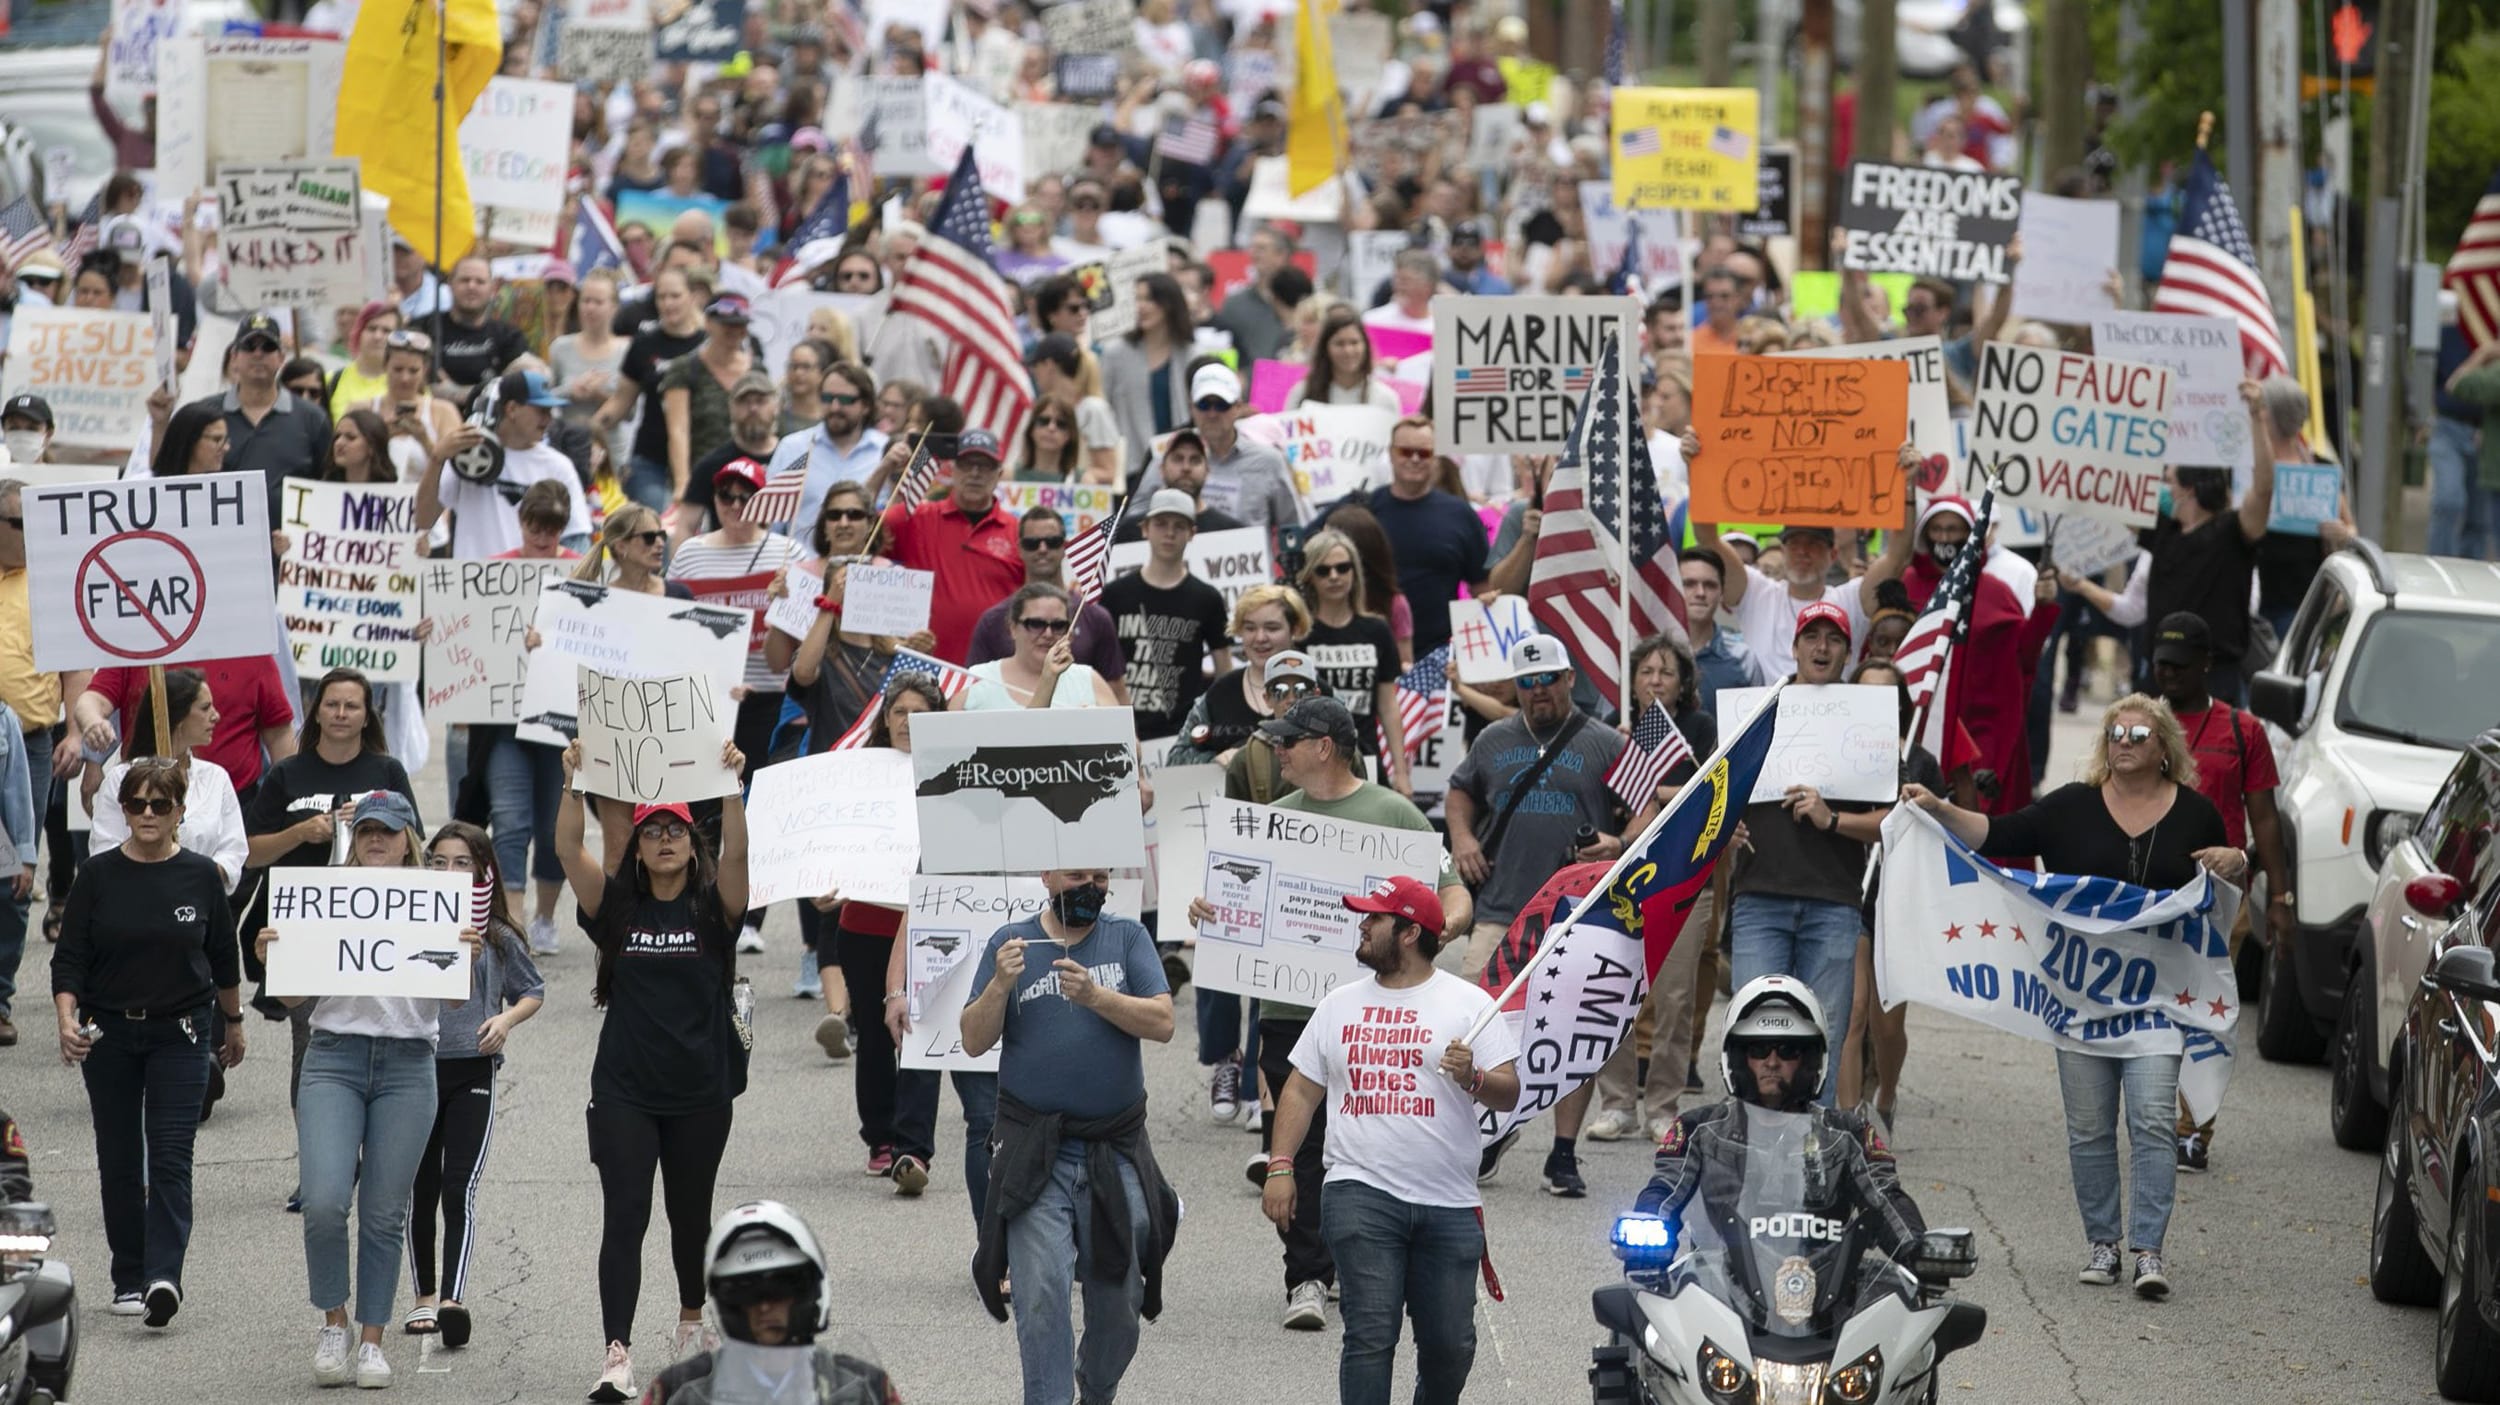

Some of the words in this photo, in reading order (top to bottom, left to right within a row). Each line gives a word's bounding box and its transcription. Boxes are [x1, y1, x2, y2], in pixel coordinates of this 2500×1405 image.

[298, 179, 352, 207] DREAM
[1852, 161, 2021, 221] FREEDOMS
[1893, 208, 1960, 240] ARE
[227, 238, 325, 270] KILLED
[1843, 228, 2011, 285] ESSENTIAL
[2189, 329, 2228, 348] FDA
[30, 356, 146, 388] SAVES
[1509, 368, 1555, 392] FOR
[1982, 345, 2044, 395] NO
[2055, 355, 2167, 412] FAUCI
[1720, 360, 1869, 418] RIGHTS
[1720, 425, 1753, 441] are
[1771, 419, 1845, 449] NOT
[1854, 426, 1877, 440] an
[1975, 400, 2039, 443] NO
[2051, 405, 2170, 458] GATES
[1965, 449, 2031, 497] NO
[2037, 457, 2161, 515] VACCINE
[37, 480, 245, 536] TRUTH
[286, 483, 313, 528] I
[302, 531, 404, 570] BECAUSE
[279, 560, 379, 593] RANTING
[388, 573, 416, 594] ON
[1204, 552, 1263, 579] WORK
[87, 575, 194, 620] FEAR
[557, 617, 590, 635] LIFE
[593, 622, 605, 639] IS
[684, 609, 737, 627] #ReopenNC
[1118, 614, 1201, 642] INVADE
[1458, 598, 1536, 663] #We
[321, 645, 398, 671] WORLD
[555, 638, 629, 664] FREEDOM
[1133, 638, 1178, 665] THE
[1326, 668, 1376, 689] IVES
[578, 669, 716, 733] #REOPEN
[955, 758, 1104, 791] #ReopenNC
[775, 800, 897, 834] WORKERS
[1221, 890, 1251, 901] PEOPLE
[1222, 881, 1235, 890] WE
[1236, 883, 1252, 893] THE
[1277, 879, 1308, 891] small
[271, 885, 461, 924] #REOPEN
[1226, 901, 1244, 909] ARE
[1279, 904, 1308, 917] faster
[1309, 908, 1332, 920] than
[1334, 912, 1350, 924] the
[1289, 894, 1312, 906] pays
[630, 930, 696, 947] TRUMP
[1285, 918, 1344, 936] government
[337, 938, 396, 972] NC
[2040, 921, 2158, 1006] 2020
[1946, 963, 2000, 1001] NO
[2012, 968, 2079, 1037] MORE
[1362, 1006, 1418, 1025] This
[1760, 1017, 1792, 1029] SHOEI
[1341, 1024, 1433, 1045] Hispanic
[1347, 1044, 1424, 1069] Always
[1348, 1067, 1417, 1092] Votes
[1750, 1216, 1843, 1243] POLICE
